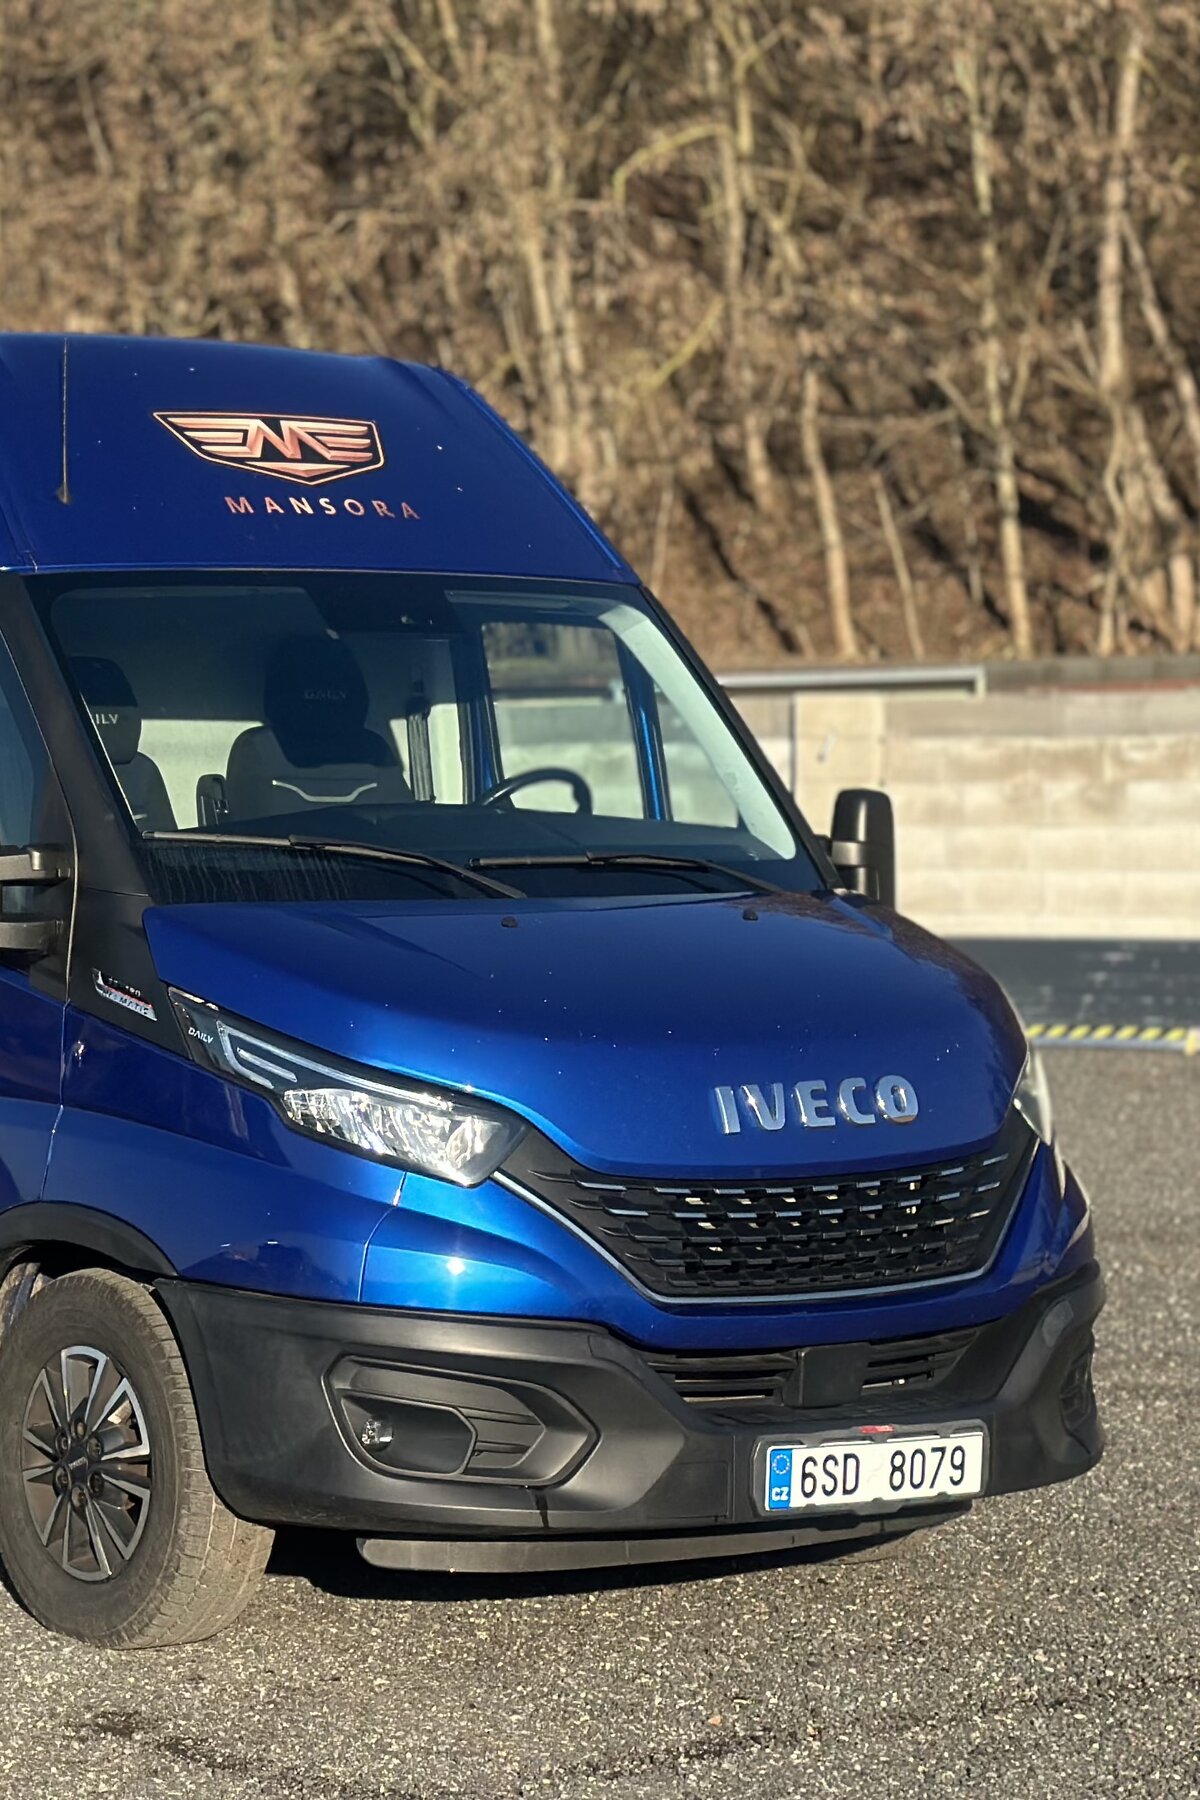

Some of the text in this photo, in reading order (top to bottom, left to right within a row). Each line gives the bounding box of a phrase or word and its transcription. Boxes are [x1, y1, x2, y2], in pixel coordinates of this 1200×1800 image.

[224, 496, 421, 520] MANSORA
[188, 1026, 214, 1044] DAILY
[714, 1074, 919, 1134] IVECO
[800, 1445, 966, 1498] 6SD 8079
[771, 1487, 789, 1501] CZ
